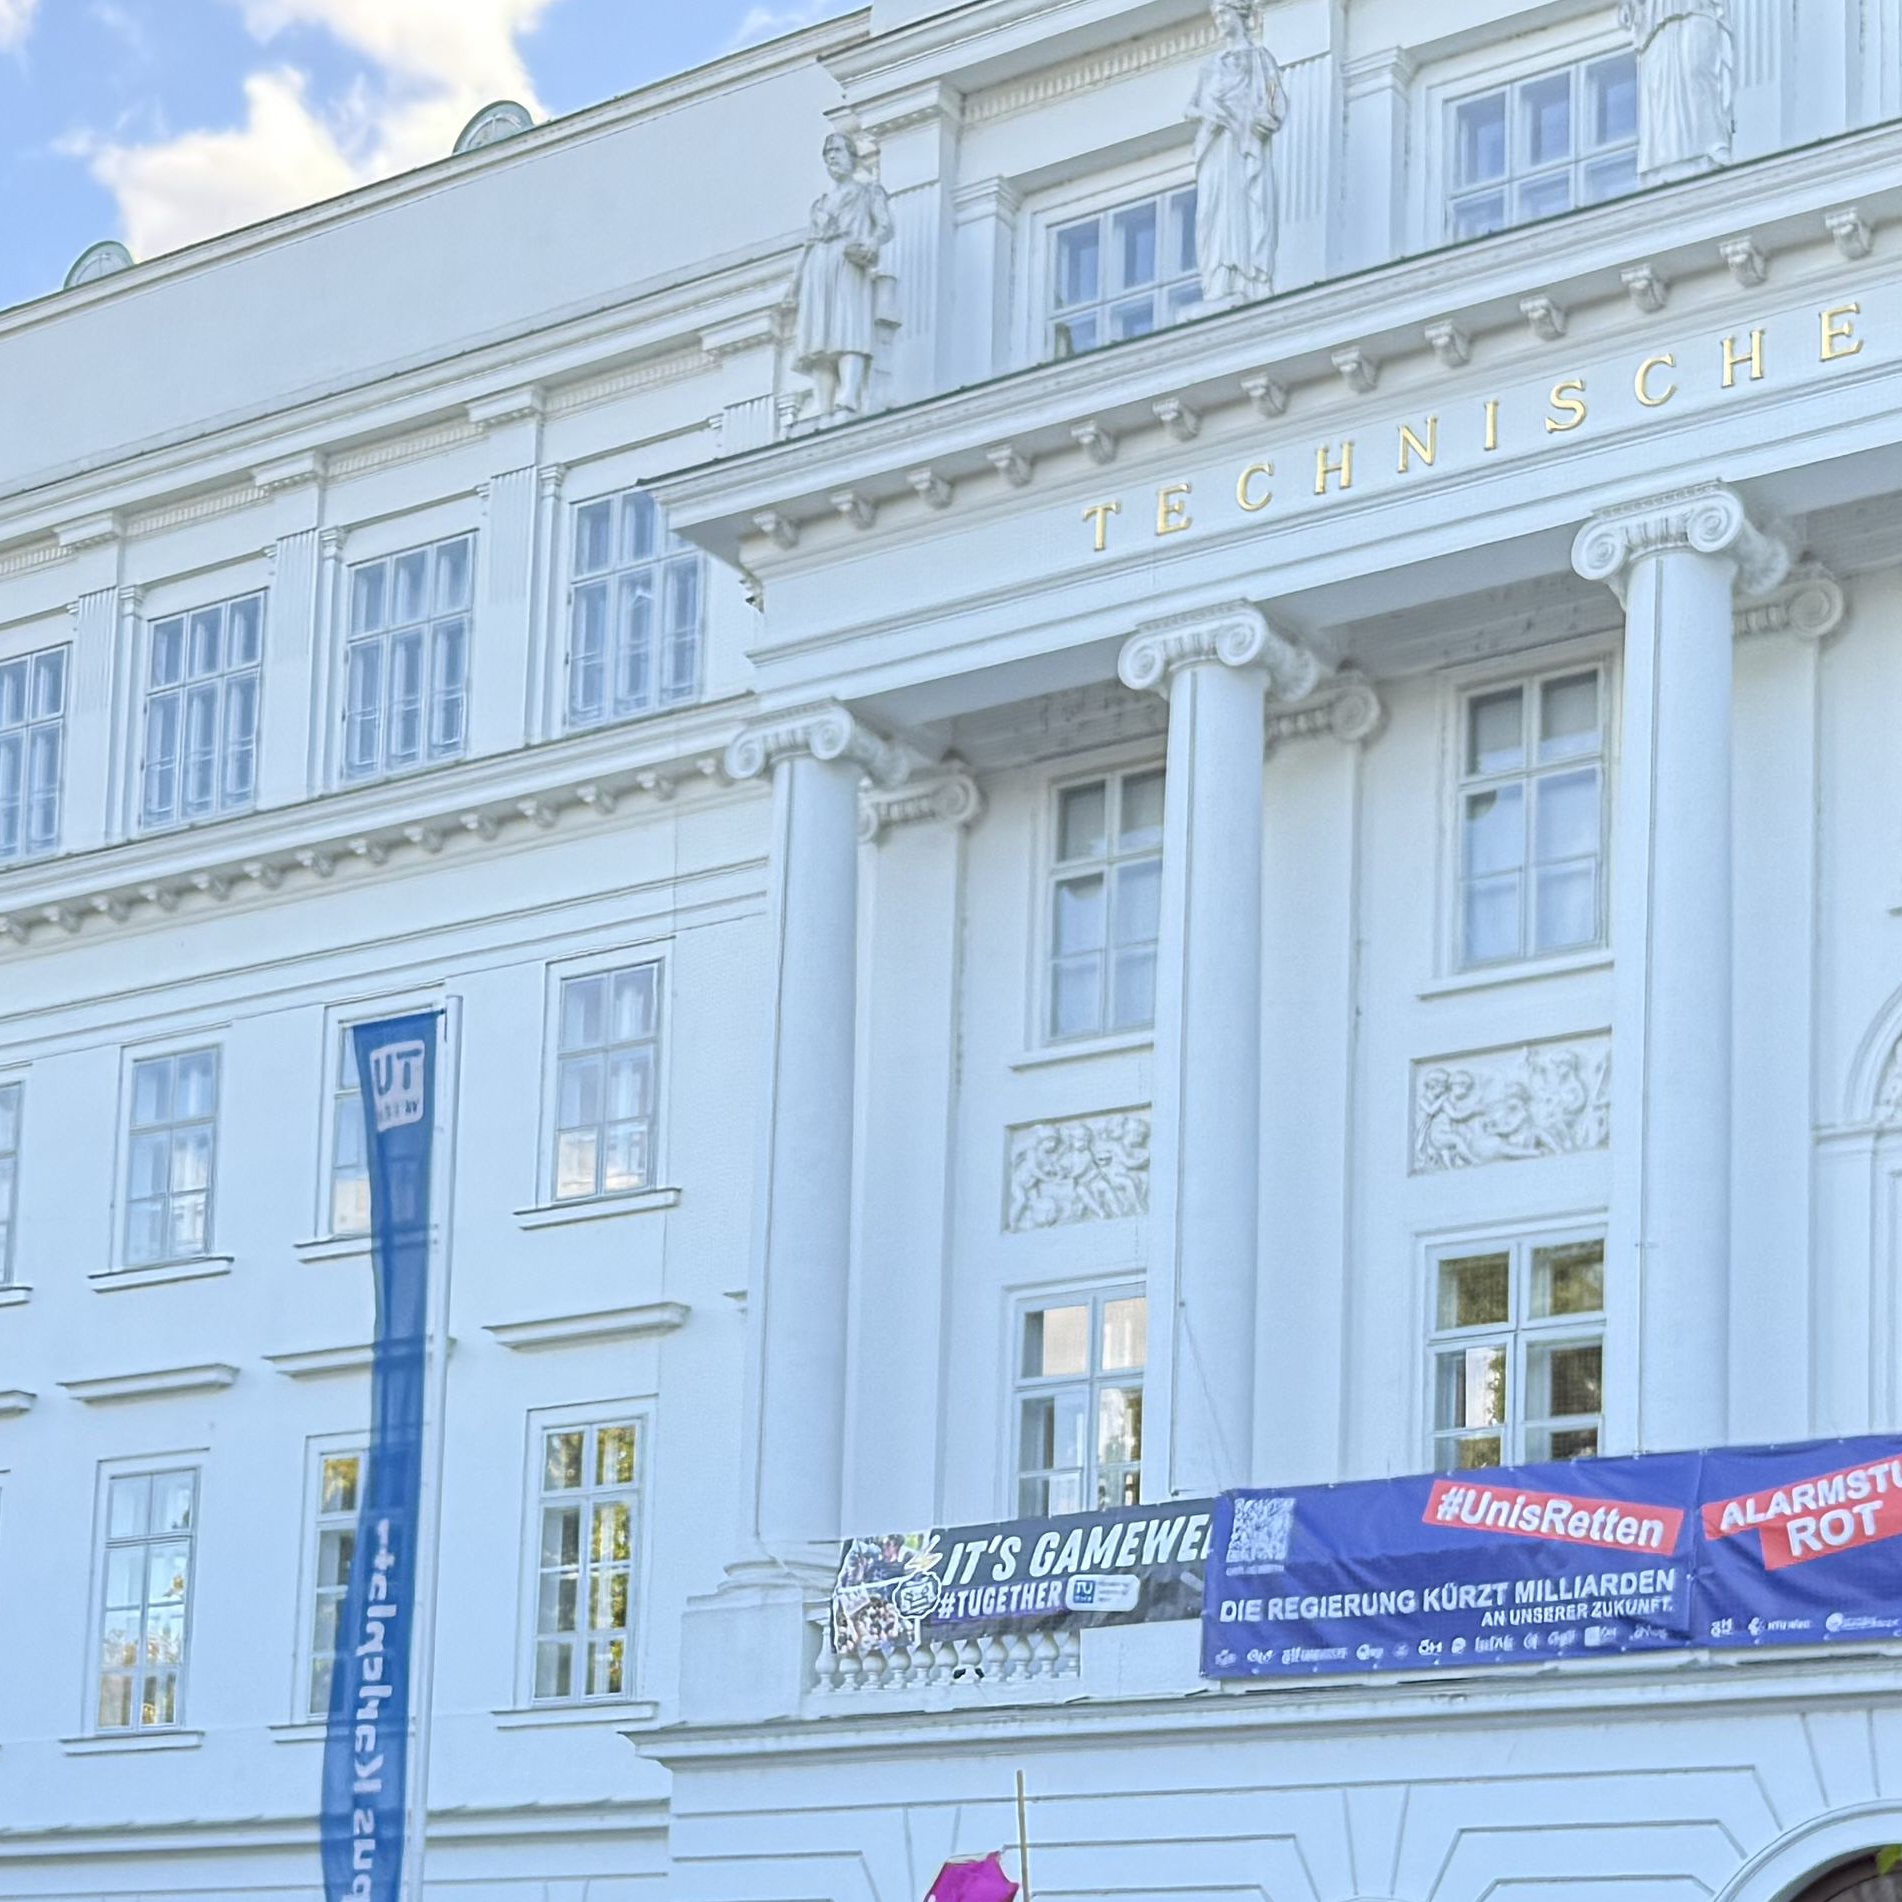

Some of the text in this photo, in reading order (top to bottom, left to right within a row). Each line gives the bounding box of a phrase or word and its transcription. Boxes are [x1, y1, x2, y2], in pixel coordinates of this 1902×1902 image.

[1081, 302, 1865, 553] TECHNISCHE
[1436, 1486, 1664, 1548] #UnisRetten
[1786, 1501, 1883, 1557] ROT
[942, 1535, 1022, 1585] IT'S
[938, 1580, 1063, 1619] #TUGETHER
[1219, 1568, 1675, 1622] DIE REGIERUNG KÜRZT MILLIARDEN
[1482, 1610, 1507, 1627] AN
[1509, 1603, 1587, 1626] UNSERER
